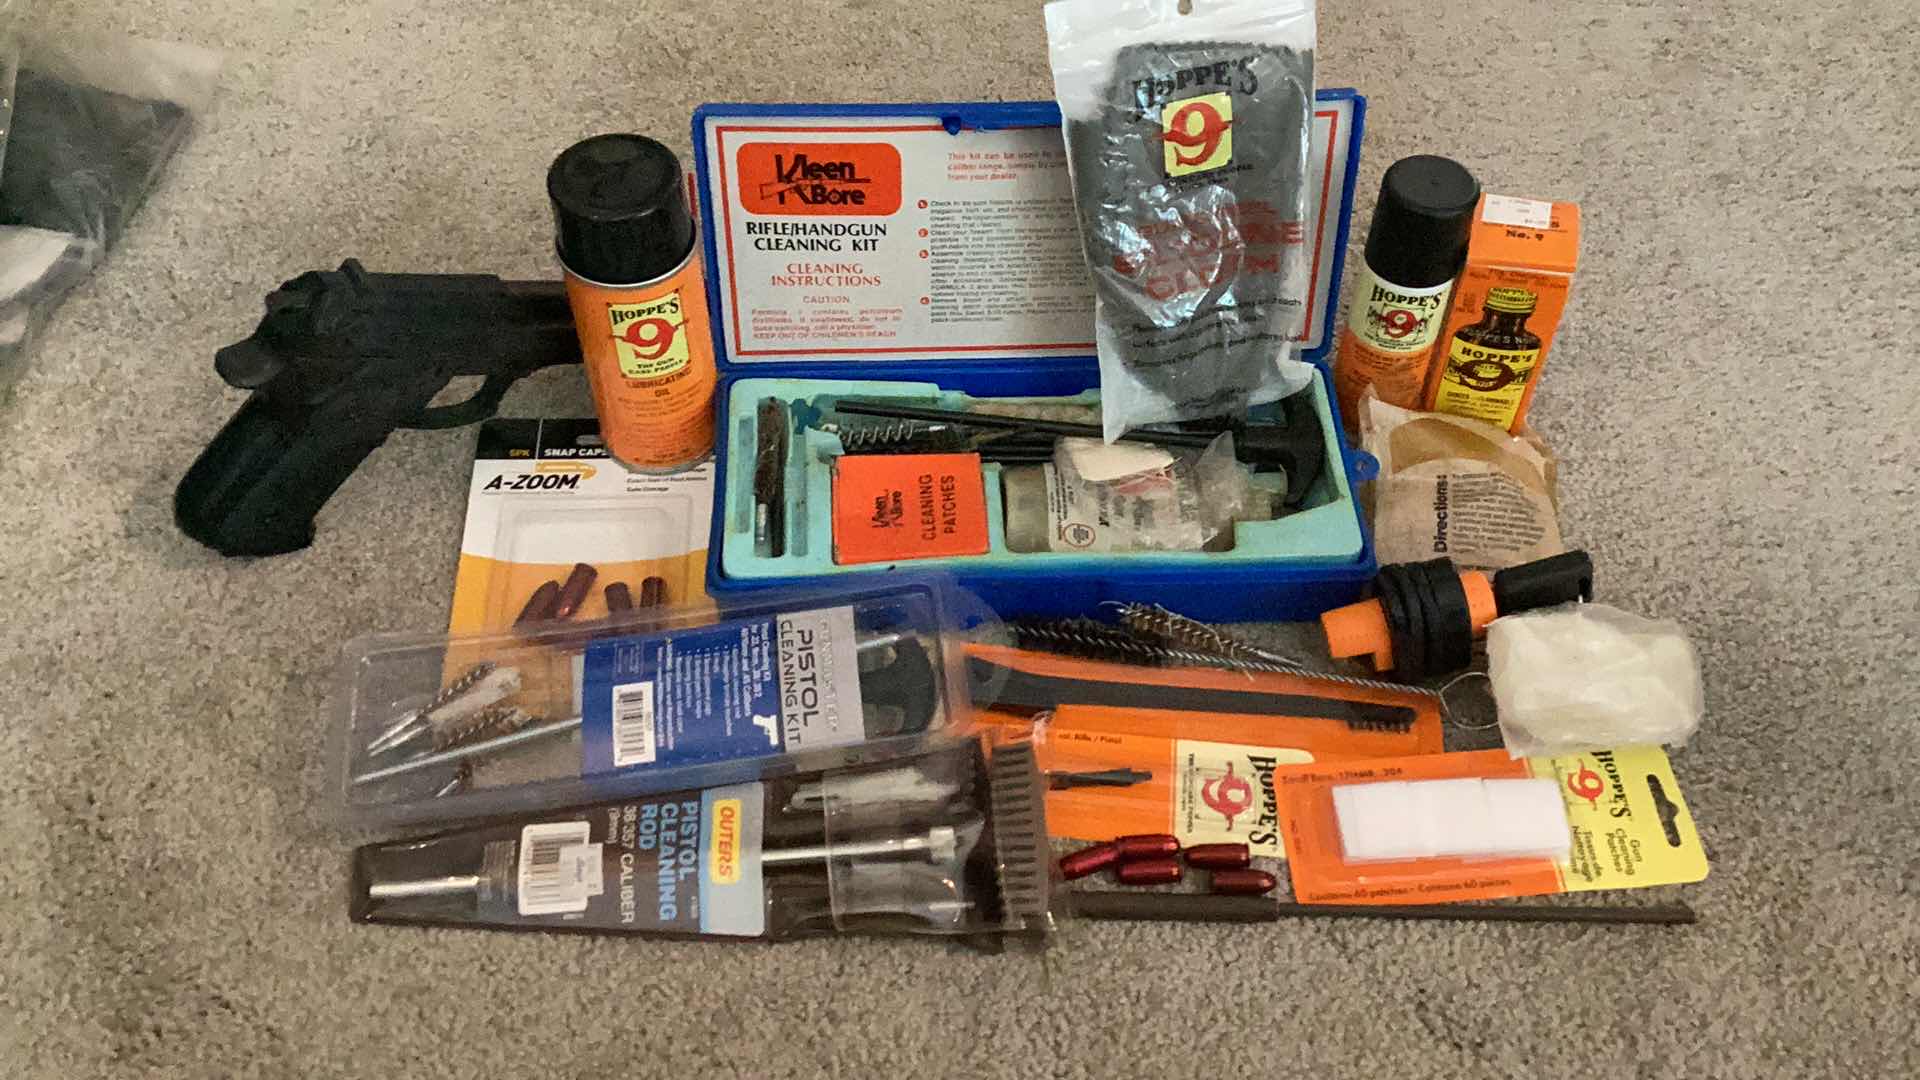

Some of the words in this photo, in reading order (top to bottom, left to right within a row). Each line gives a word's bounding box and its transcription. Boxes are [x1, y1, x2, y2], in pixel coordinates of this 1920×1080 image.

[1165, 102, 1231, 167] 9
[775, 154, 860, 184] Kleen
[811, 184, 866, 205] Bore
[745, 221, 887, 237] RIFLE/HANDGUN
[754, 237, 842, 252] CLEANING
[851, 238, 880, 252] KIT
[772, 275, 881, 288] INSTRUCTIONS
[787, 263, 864, 275] CLEANING
[611, 297, 680, 325] HOPPE'S
[803, 295, 850, 304] CAUTION
[1370, 284, 1443, 310] HOPPE'S
[621, 317, 680, 359] 9
[1462, 346, 1533, 363] HOPPE'S
[625, 366, 693, 389] LUBRICATING
[654, 388, 671, 398] OIL
[544, 448, 577, 457] SNAP
[484, 474, 582, 490] A-ZOOM
[919, 474, 936, 540] CLEANING
[941, 475, 956, 534] PATCHES
[1433, 474, 1448, 552] Directions:
[781, 620, 798, 708] CLEANING
[797, 629, 819, 727] PISTOL
[787, 714, 801, 744] KIT
[1201, 774, 1253, 819] 9
[1247, 754, 1278, 845] HOPPE'S
[1567, 768, 1604, 802] 9
[1591, 750, 1632, 818] HOPPE'S
[639, 803, 658, 850] ROD
[679, 801, 699, 881] PISTOL
[719, 806, 735, 877] OUTERS
[658, 802, 679, 921] CLEANING
[1606, 832, 1623, 873] Patches
[1615, 828, 1635, 876] Cleaning
[1630, 839, 1642, 862] Gun
[620, 853, 636, 924] CALIBER
